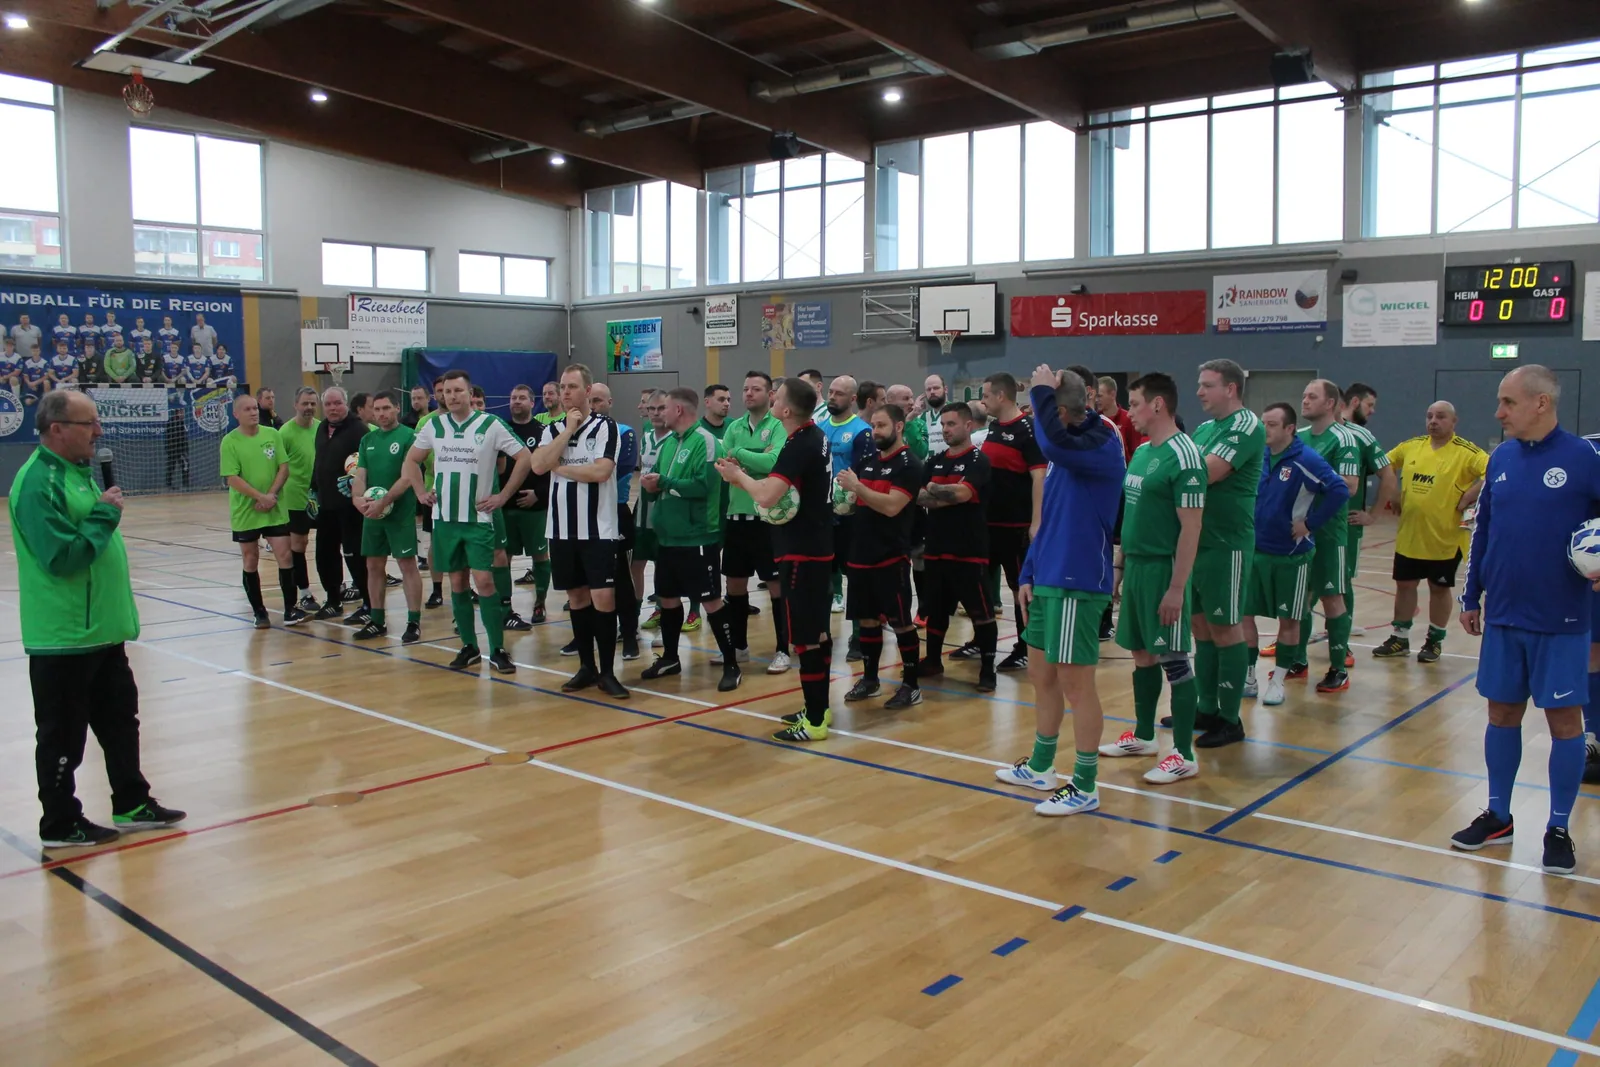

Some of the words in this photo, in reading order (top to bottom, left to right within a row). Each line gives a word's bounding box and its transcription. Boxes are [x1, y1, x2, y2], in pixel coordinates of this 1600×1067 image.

[1240, 288, 1289, 299] RAINBOW
[1454, 291, 1479, 300] HEIM
[1533, 288, 1561, 297] GAST
[0, 292, 81, 307] NDBALL
[88, 293, 125, 309] FÜR
[132, 298, 161, 310] DIE
[357, 297, 425, 315] Riesebeck
[1240, 298, 1289, 307] SANIERUNGEN
[1380, 301, 1431, 311] WICKEL
[1469, 300, 1484, 321] 0
[1499, 299, 1513, 320] 0
[1550, 297, 1566, 319] 0
[351, 313, 425, 325] Baumaschinen
[1079, 310, 1158, 331] Sparkasse
[611, 325, 632, 336] ALLES
[633, 323, 657, 334] GEBEN
[97, 404, 162, 417] WICKEL
[118, 426, 165, 434] Stavenhage
[1411, 472, 1435, 484] WWK
